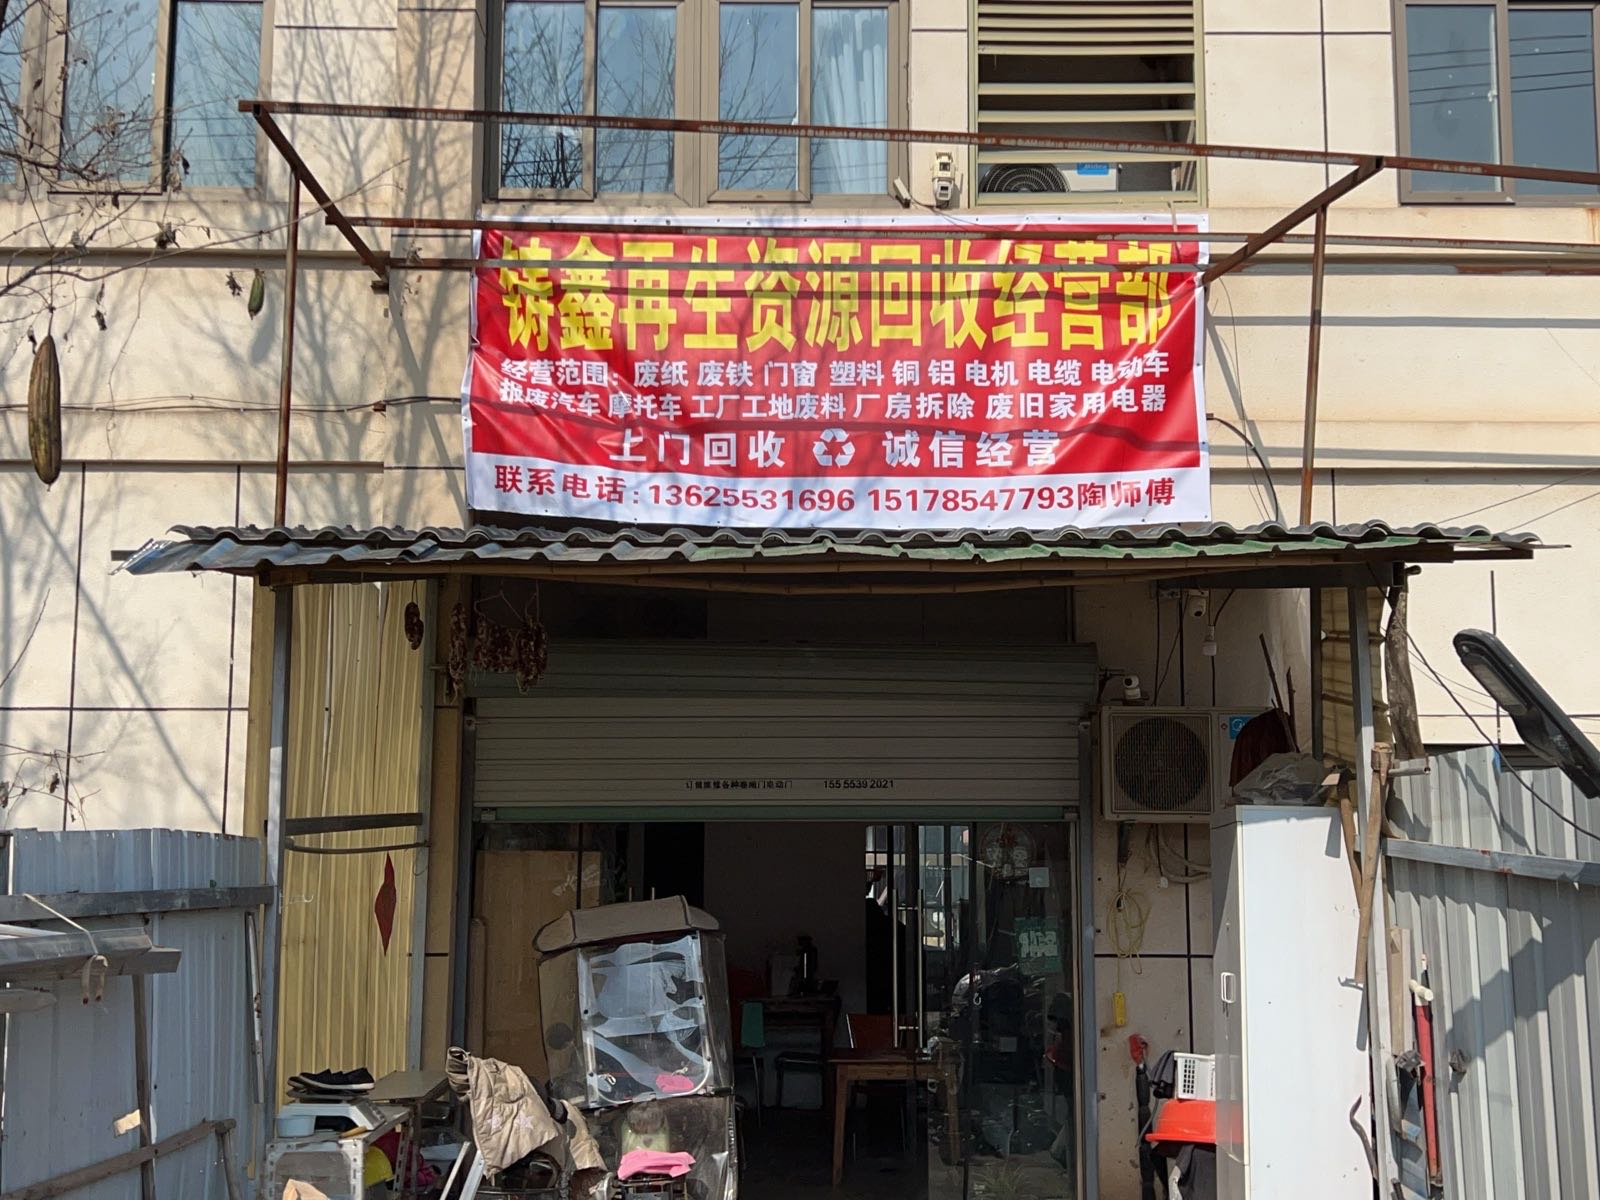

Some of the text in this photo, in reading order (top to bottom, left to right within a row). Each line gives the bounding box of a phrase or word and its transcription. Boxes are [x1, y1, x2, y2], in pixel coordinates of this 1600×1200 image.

[634, 359, 690, 388] 废纸
[696, 360, 754, 387] 废铁
[763, 360, 817, 387] 门窗
[829, 359, 885, 388] 塑料
[892, 360, 921, 387] 铜
[928, 360, 955, 387] 铝
[965, 359, 1019, 388] 电机
[1028, 359, 1083, 388] 电缆
[1091, 350, 1170, 387] 电动车
[500, 377, 600, 417] 报废汽车
[608, 391, 683, 420] 摩托车
[985, 383, 1167, 420] 废旧家用电器
[609, 427, 1061, 469] 上门回收 诚信经营
